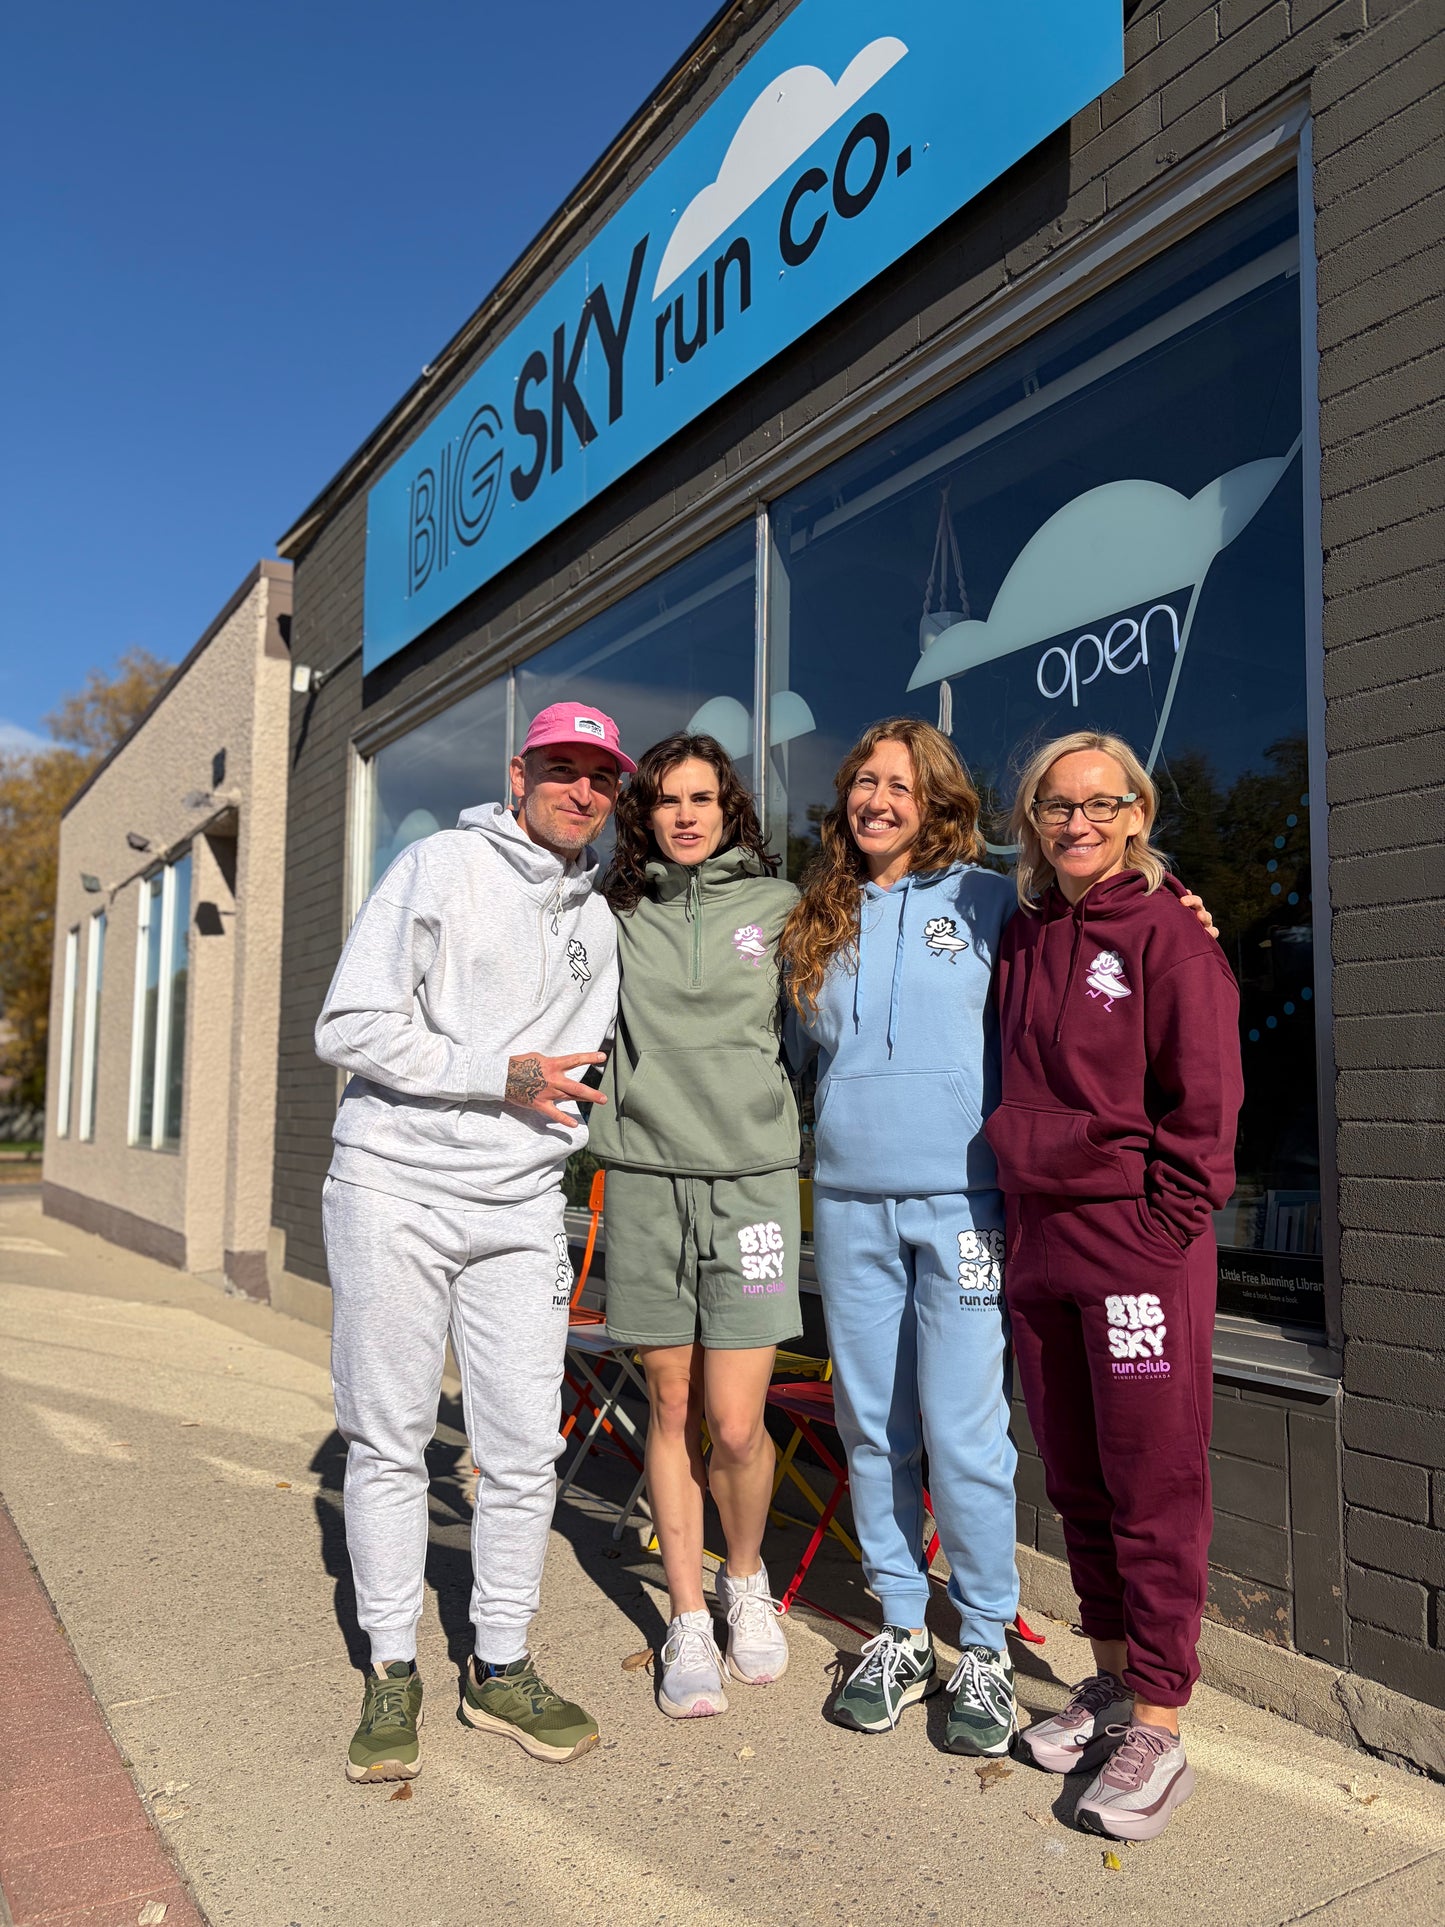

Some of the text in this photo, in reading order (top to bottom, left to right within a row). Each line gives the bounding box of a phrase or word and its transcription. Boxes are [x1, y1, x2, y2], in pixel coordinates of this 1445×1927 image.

[408, 112, 912, 598] BIG SKY run co.
[1036, 604, 1180, 707] open
[737, 1221, 784, 1254] BIG
[957, 1229, 1006, 1263] BIG
[741, 1251, 785, 1280] SKY
[958, 1261, 1005, 1292] SKY
[1220, 1268, 1240, 1281] Little
[1242, 1271, 1258, 1284] Free
[1260, 1273, 1295, 1292] Running
[553, 1295, 567, 1305] run
[742, 1284, 764, 1294] run
[959, 1293, 1003, 1306] run club
[1105, 1292, 1165, 1330] BIG
[1107, 1325, 1167, 1359] SKY
[1111, 1359, 1171, 1375] run club
